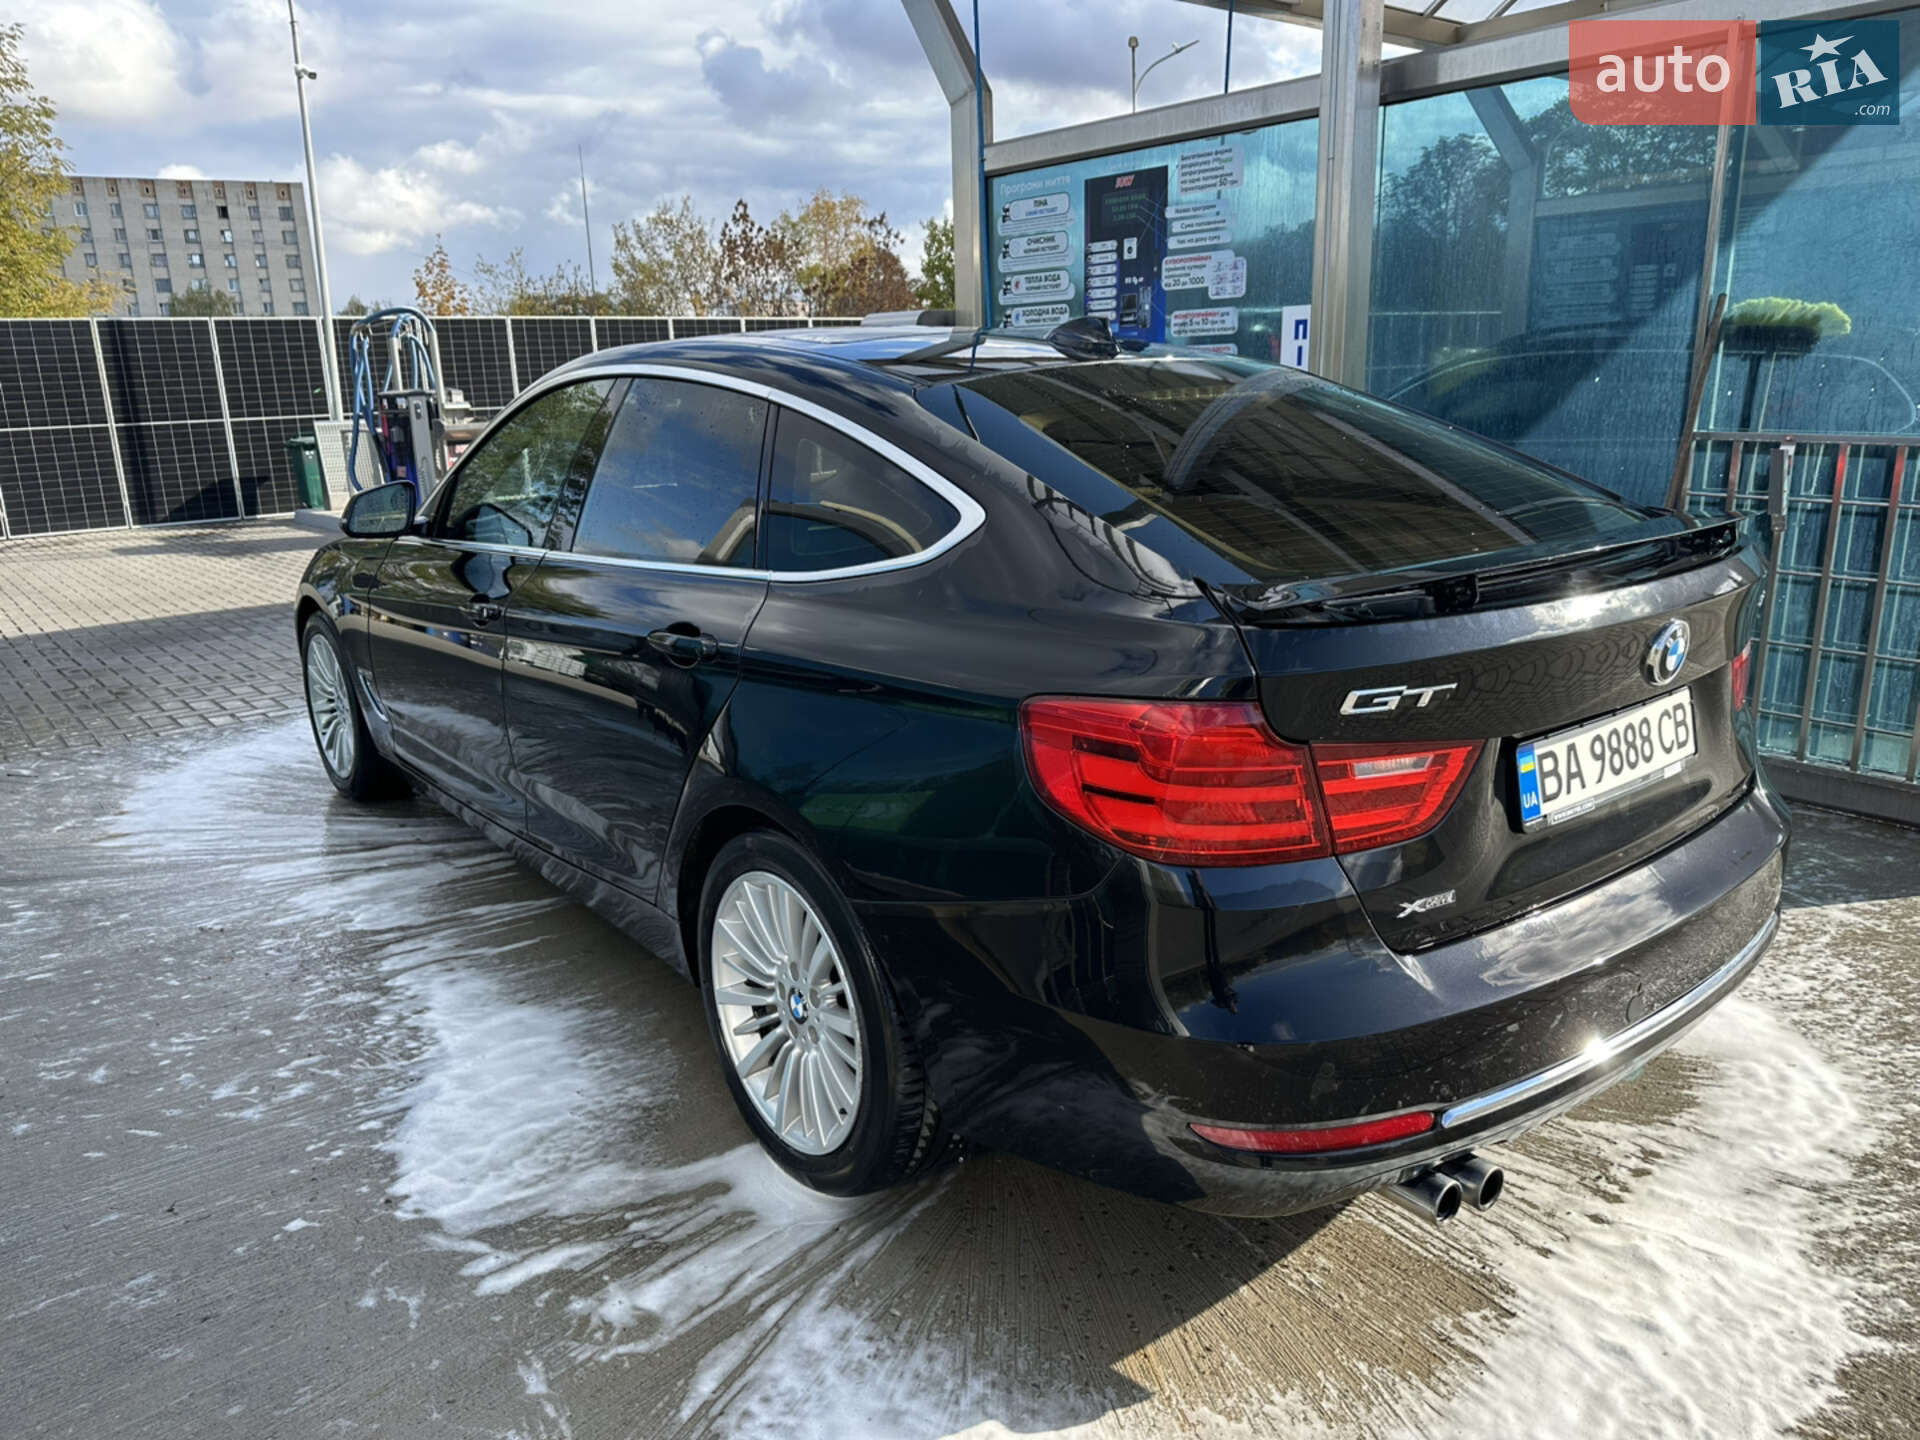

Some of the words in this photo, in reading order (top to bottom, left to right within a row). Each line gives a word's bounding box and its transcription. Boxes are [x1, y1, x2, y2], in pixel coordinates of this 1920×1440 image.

[1219, 178, 1228, 186] 50
[1172, 279, 1180, 287] 20
[1189, 276, 1205, 285] 1000
[1340, 682, 1458, 715] GT
[1537, 742, 1586, 804] BA
[1590, 717, 1654, 784] 9888
[1658, 702, 1690, 754] CB
[1523, 791, 1538, 809] UA
